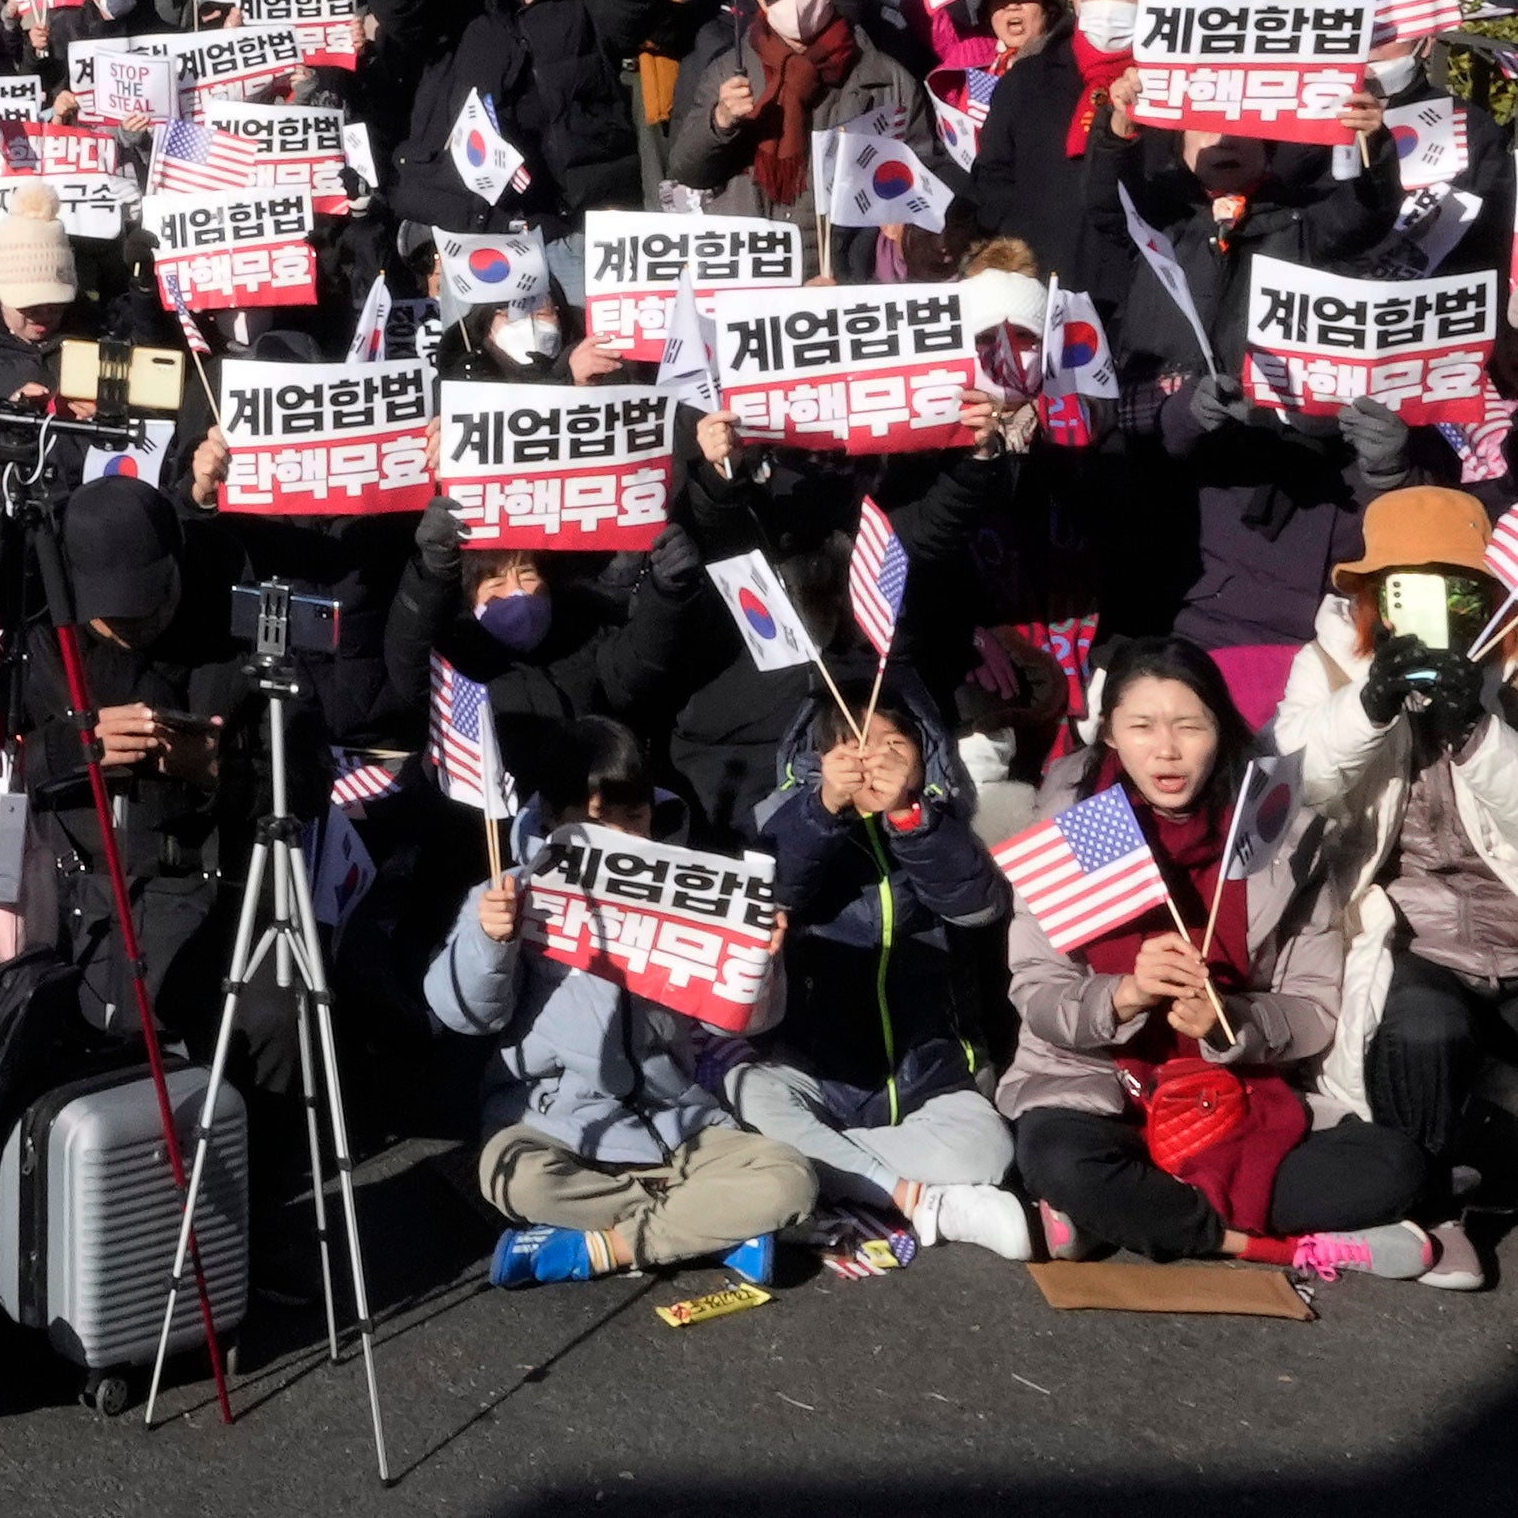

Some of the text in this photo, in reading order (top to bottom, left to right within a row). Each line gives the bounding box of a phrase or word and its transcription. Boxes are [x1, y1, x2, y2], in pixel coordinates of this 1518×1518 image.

[1140, 6, 1363, 55] 계엄합법
[161, 245, 312, 306] 탄핵무효
[594, 231, 793, 282] 계엄합법
[728, 294, 964, 371] 계엄합법
[1257, 283, 1488, 350] 계엄합법
[227, 369, 424, 436] 계엄합법
[729, 369, 966, 441] 탄핵무효
[1250, 350, 1484, 408] 탄핵무효
[452, 396, 665, 466] 계엄합법
[226, 436, 429, 505] 탄핵무효
[454, 467, 667, 540] 탄핵무효
[522, 889, 767, 1004] 탄핵무효
